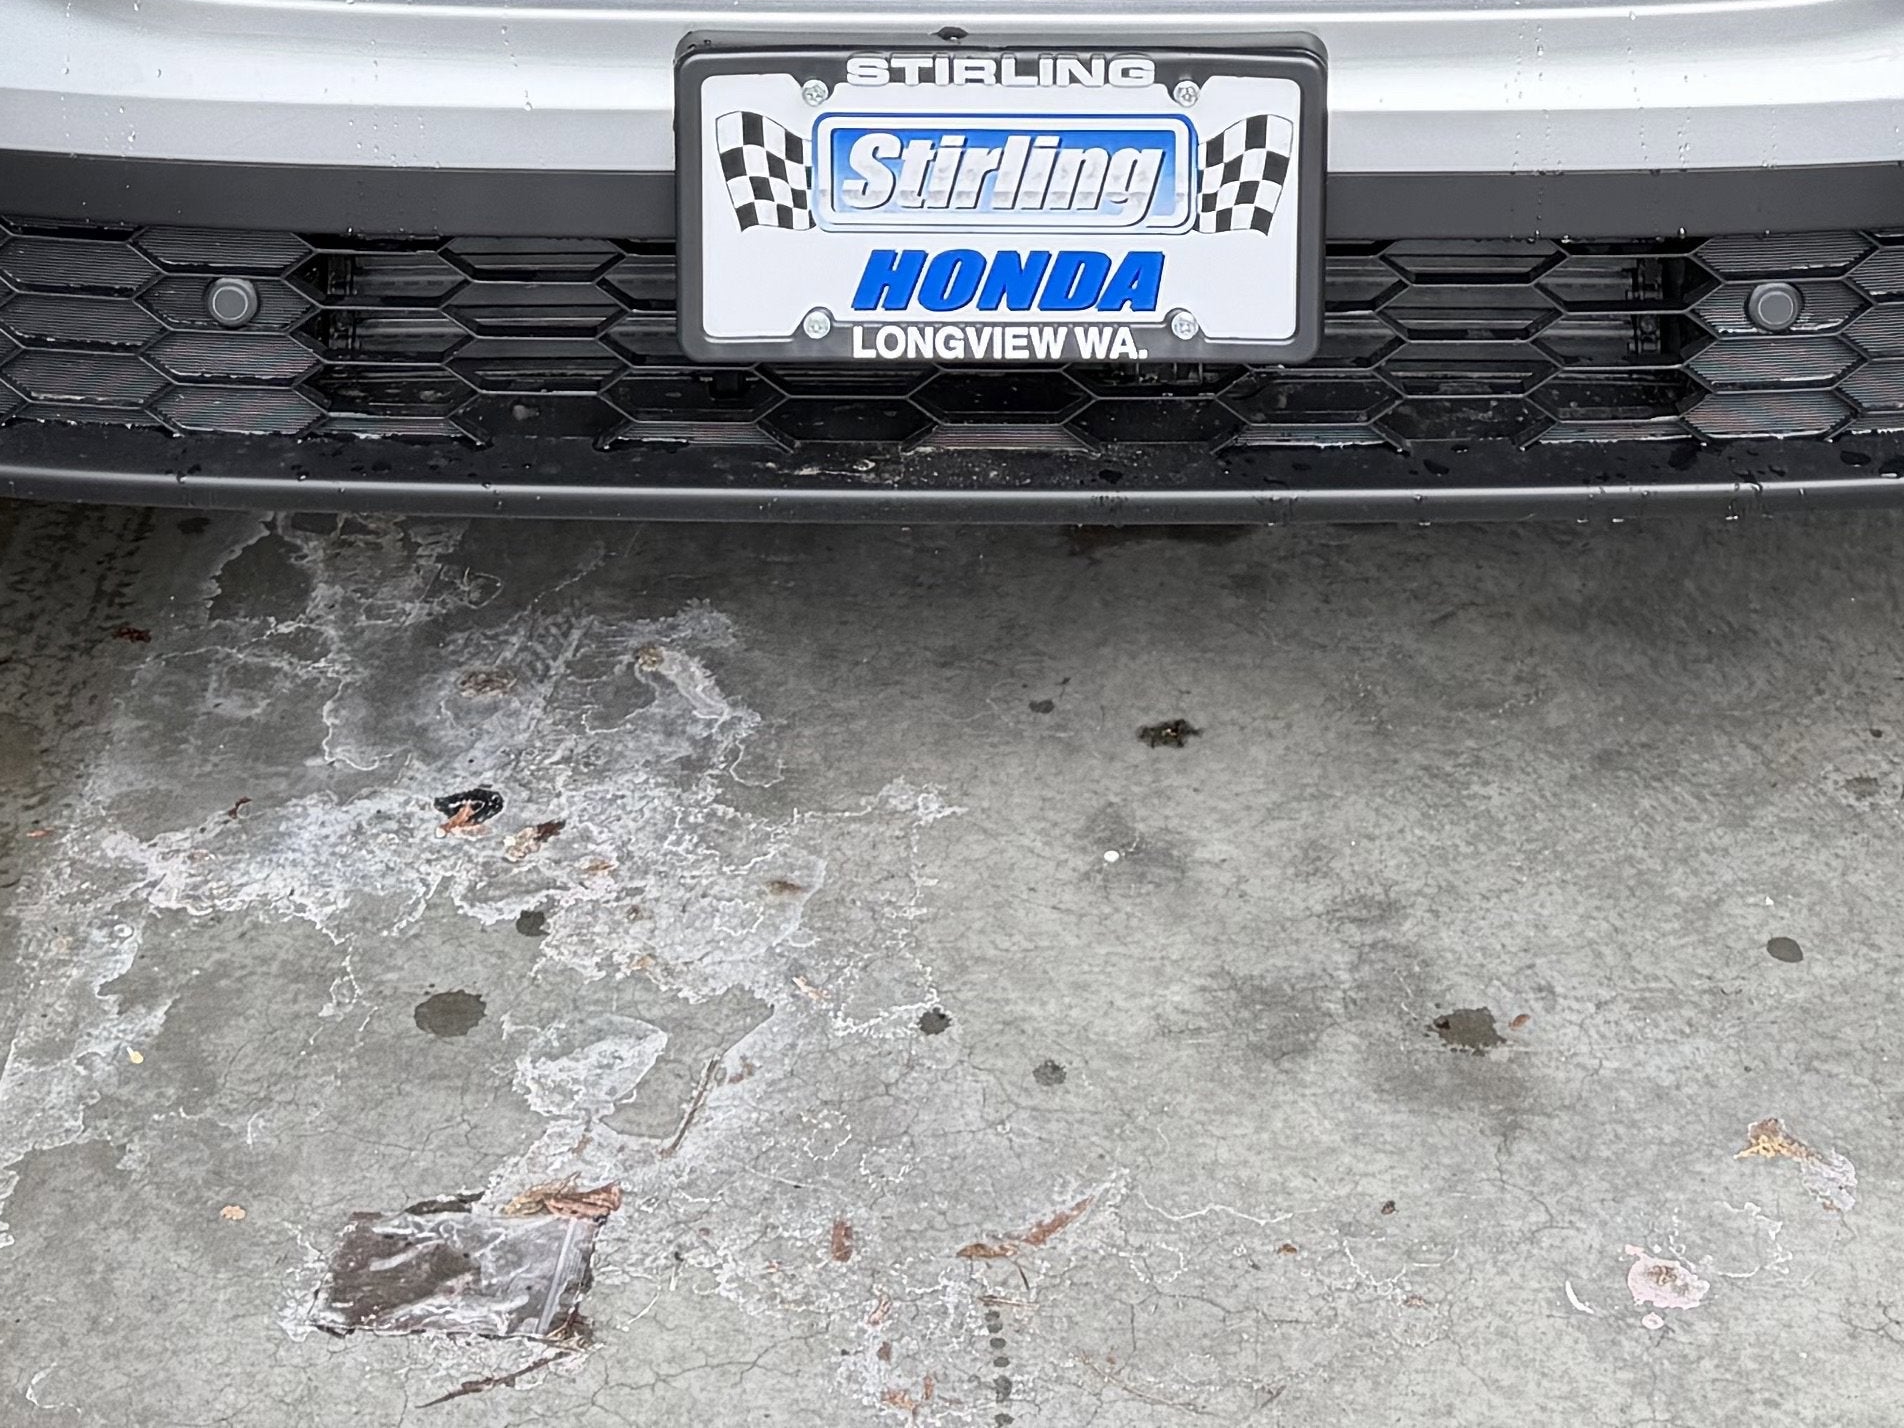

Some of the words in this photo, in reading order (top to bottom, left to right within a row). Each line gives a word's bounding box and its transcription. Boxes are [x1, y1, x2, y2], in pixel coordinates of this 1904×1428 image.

[845, 53, 1157, 88] STIRLING
[843, 132, 1165, 223] Stirling
[851, 248, 1166, 312] HONDA
[852, 325, 1069, 359] LONGVIEW
[1074, 325, 1148, 359] WA.
